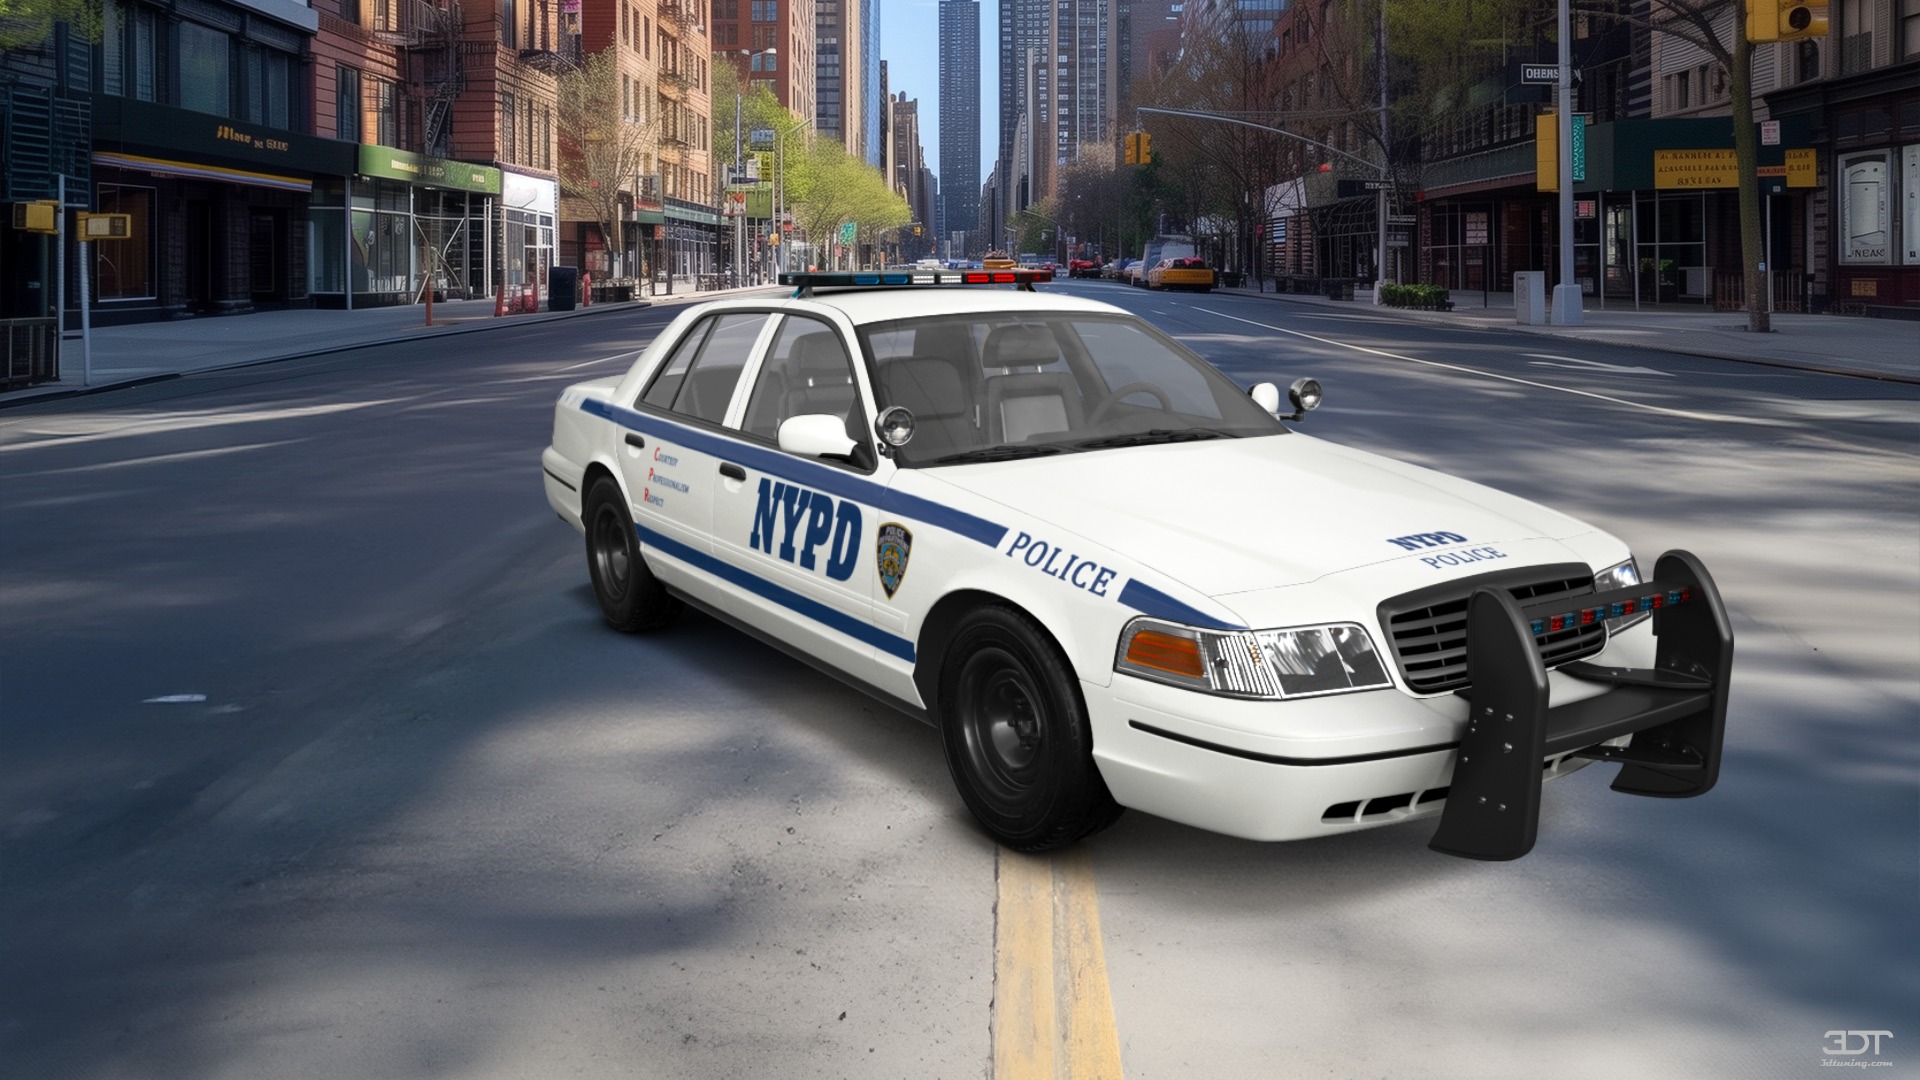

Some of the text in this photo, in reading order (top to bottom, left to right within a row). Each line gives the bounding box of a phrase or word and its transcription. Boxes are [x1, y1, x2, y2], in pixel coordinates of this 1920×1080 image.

[749, 476, 863, 582] NYPD
[885, 525, 906, 539] POLICE
[1385, 530, 1468, 551] NYPD
[1005, 530, 1118, 598] POLICE
[1418, 546, 1509, 569] POLICE
